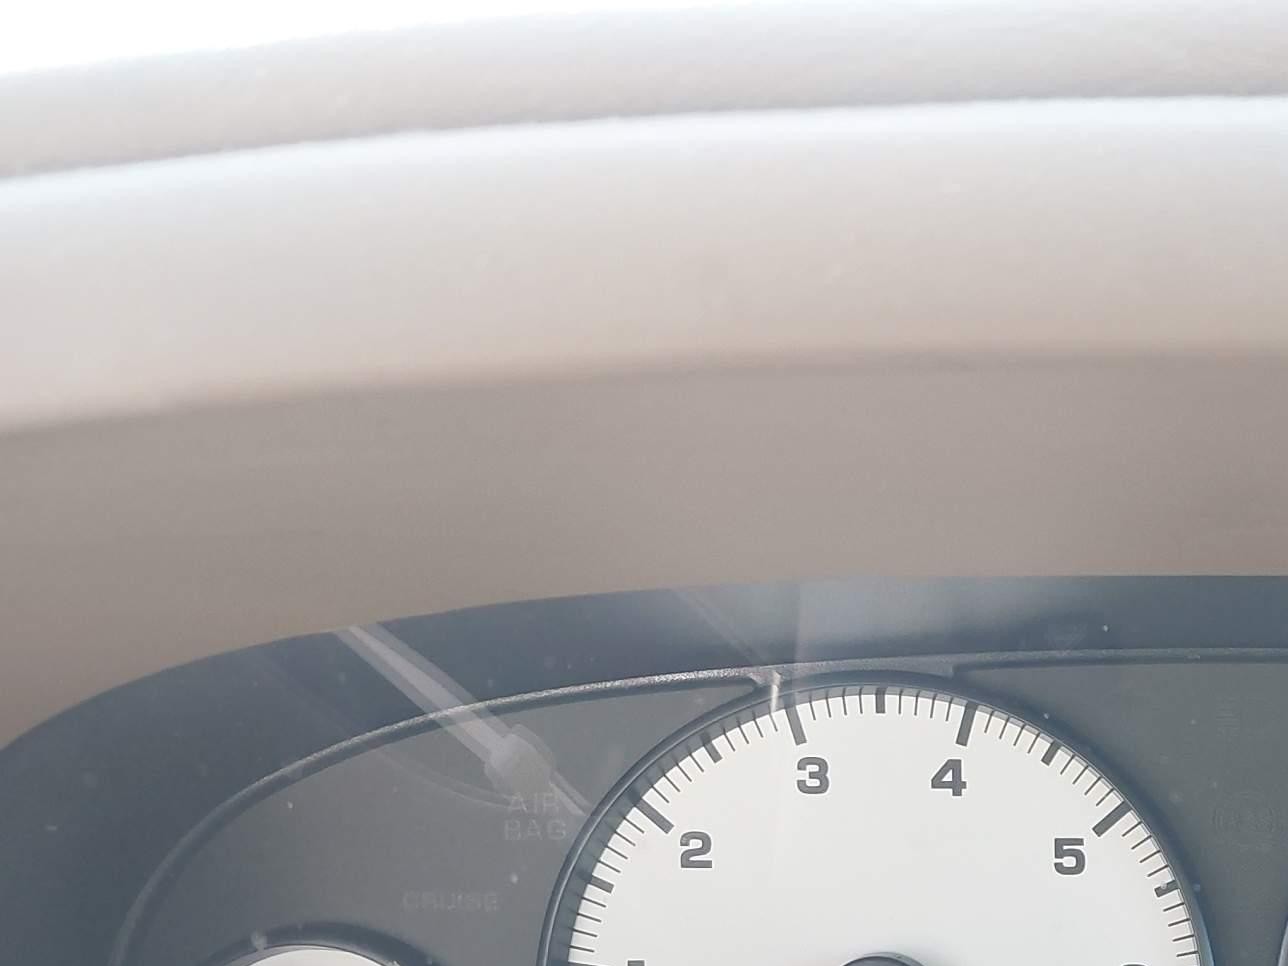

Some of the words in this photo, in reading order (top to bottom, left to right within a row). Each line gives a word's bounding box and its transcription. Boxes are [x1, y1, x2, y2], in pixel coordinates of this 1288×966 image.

[796, 757, 830, 795] 3
[931, 759, 967, 796] 4
[679, 831, 713, 869] 2
[1053, 837, 1086, 875] 5
